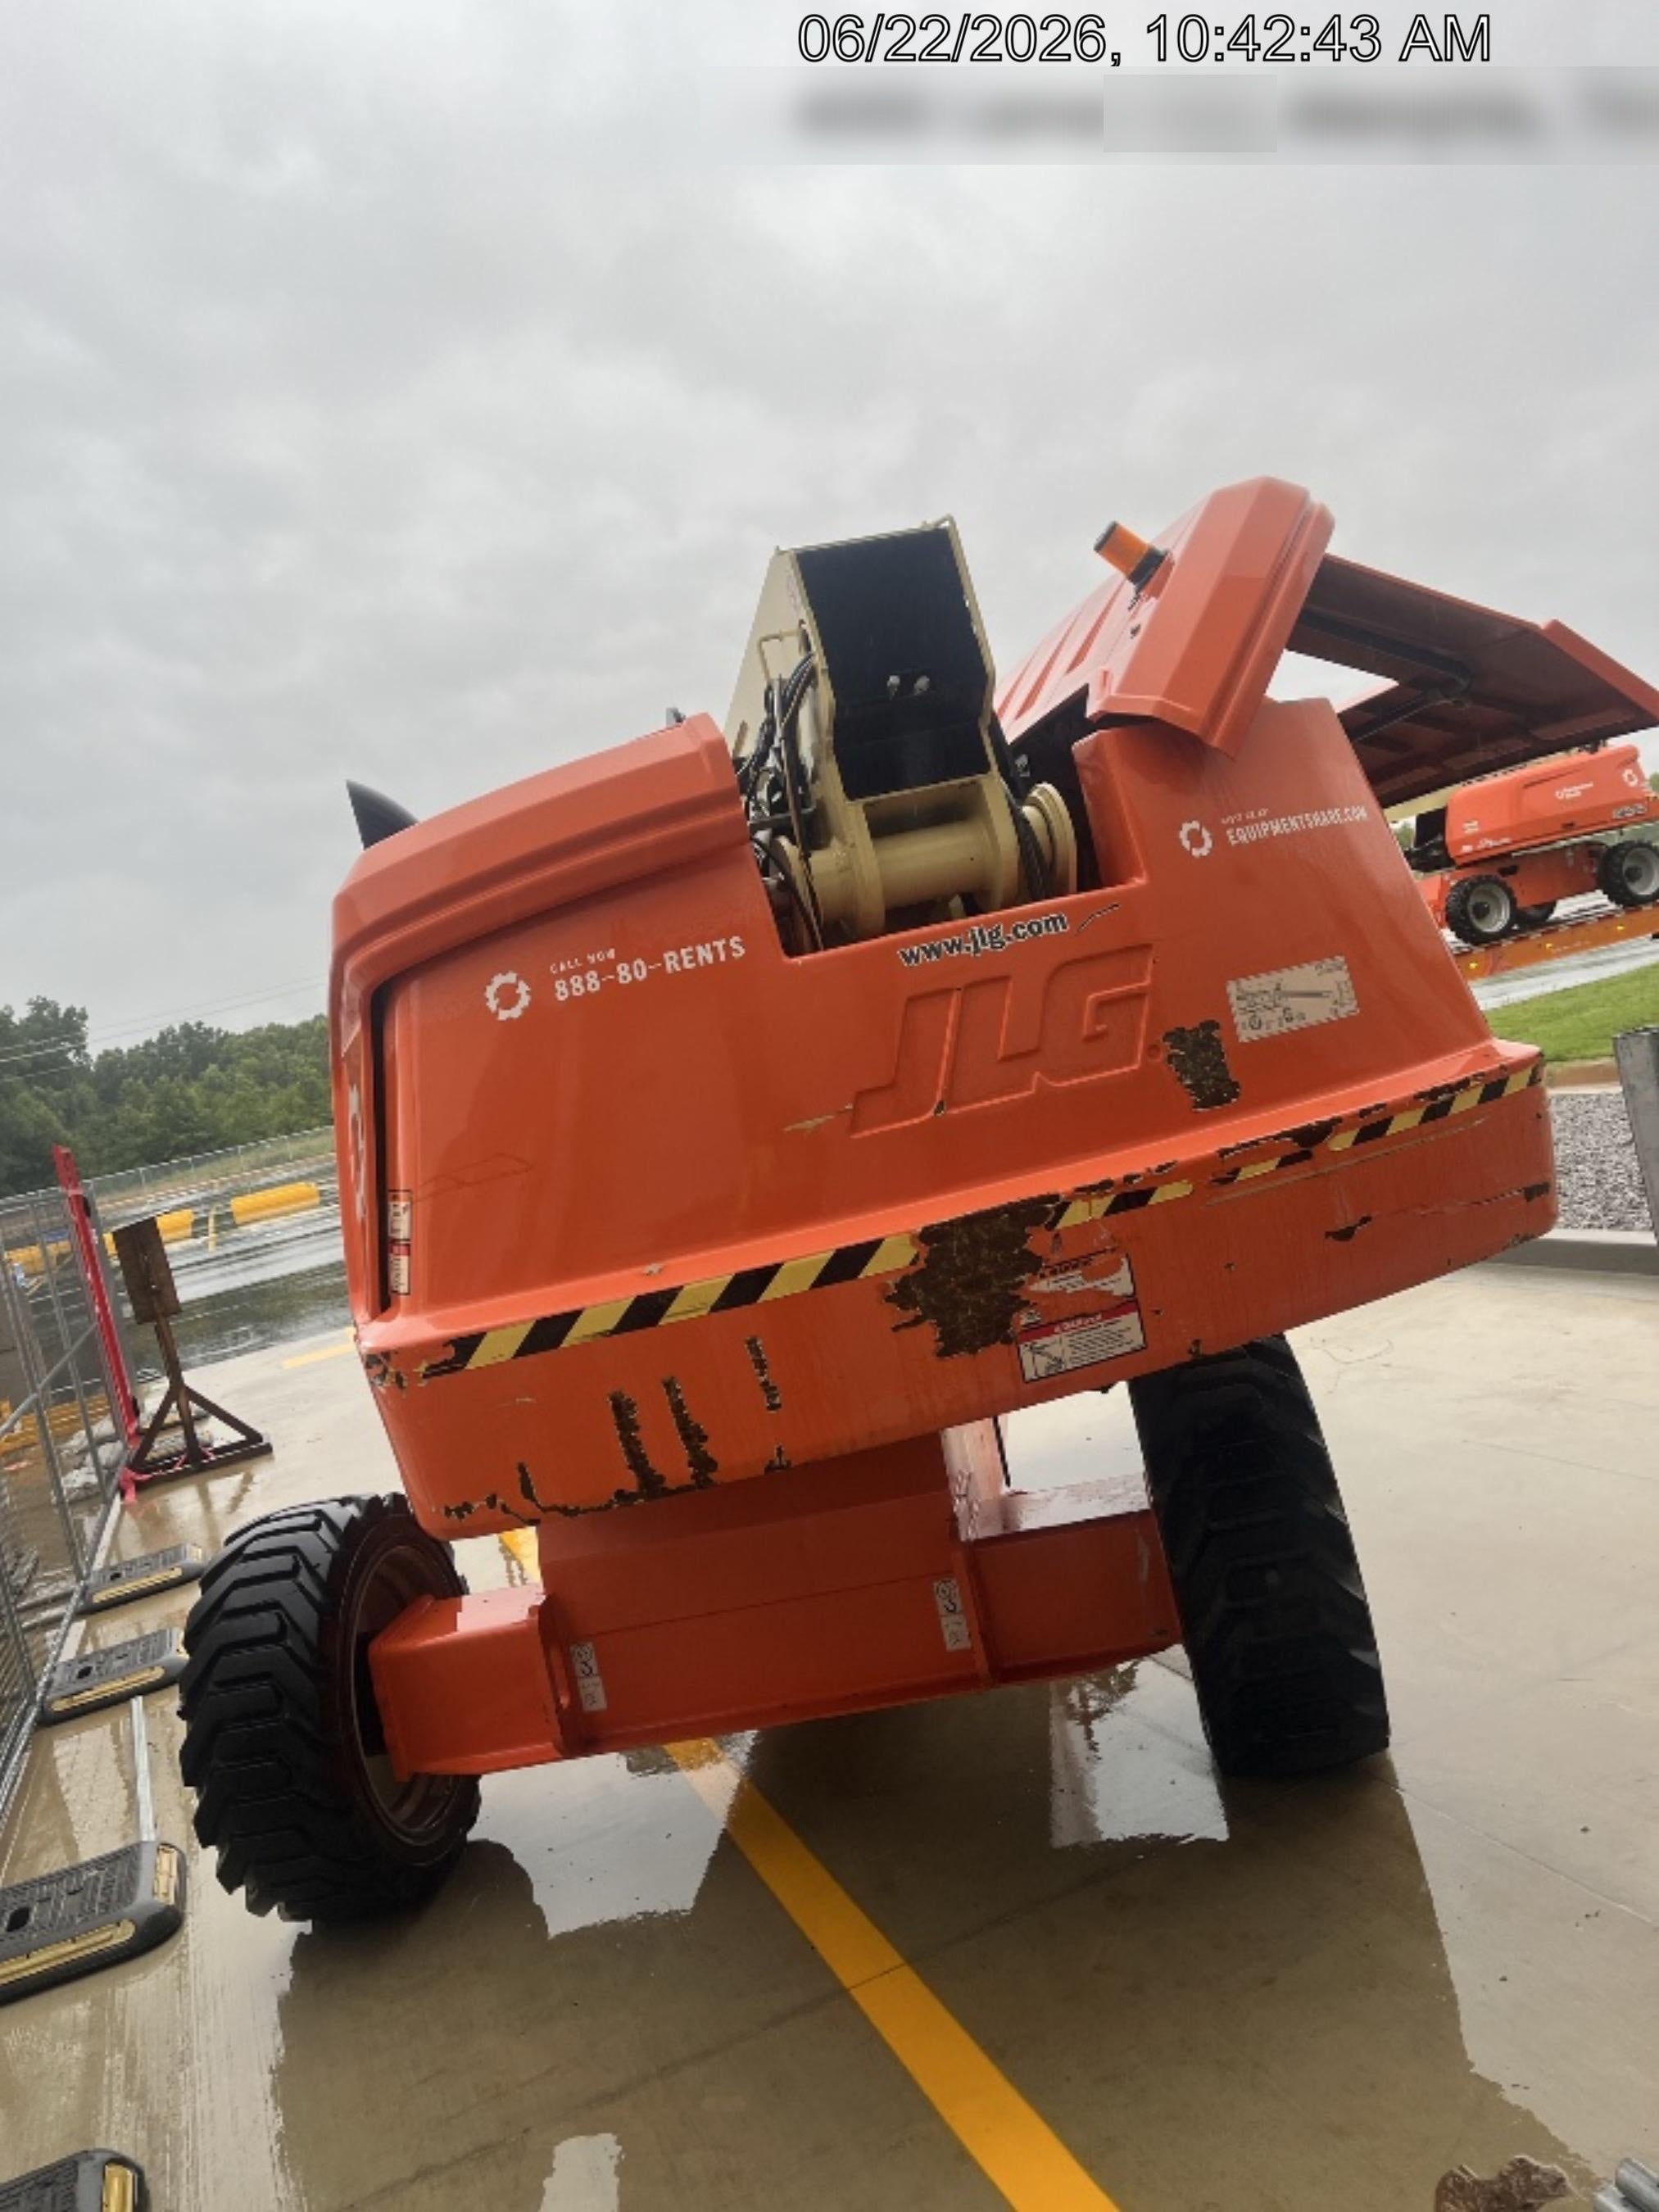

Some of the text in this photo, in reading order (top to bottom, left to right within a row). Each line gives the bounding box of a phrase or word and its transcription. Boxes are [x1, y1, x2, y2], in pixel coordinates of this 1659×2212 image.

[554, 935, 745, 1001] 888-80-RENTS
[900, 912, 1068, 967] www.jlg.com
[850, 943, 1154, 1139] JLG
